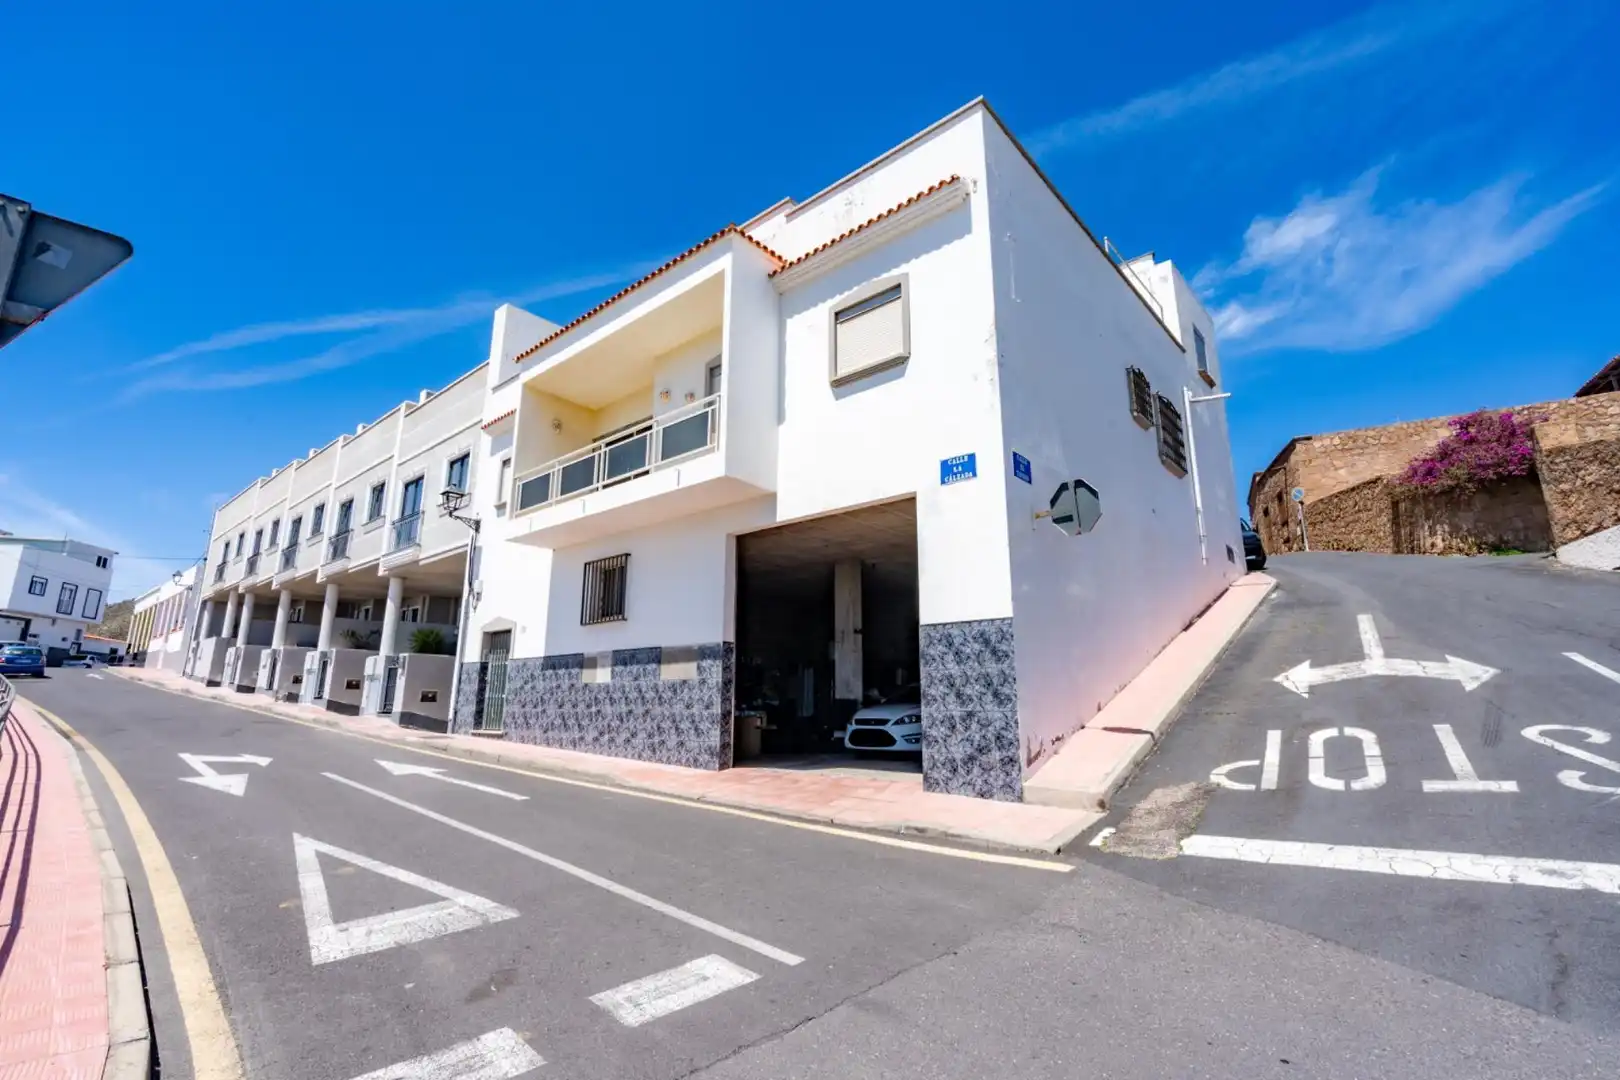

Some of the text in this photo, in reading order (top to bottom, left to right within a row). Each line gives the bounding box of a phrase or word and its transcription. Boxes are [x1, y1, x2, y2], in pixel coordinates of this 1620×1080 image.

[947, 455, 969, 465] CALLE
[953, 465, 962, 473] LA
[1209, 724, 1620, 794] STOP
